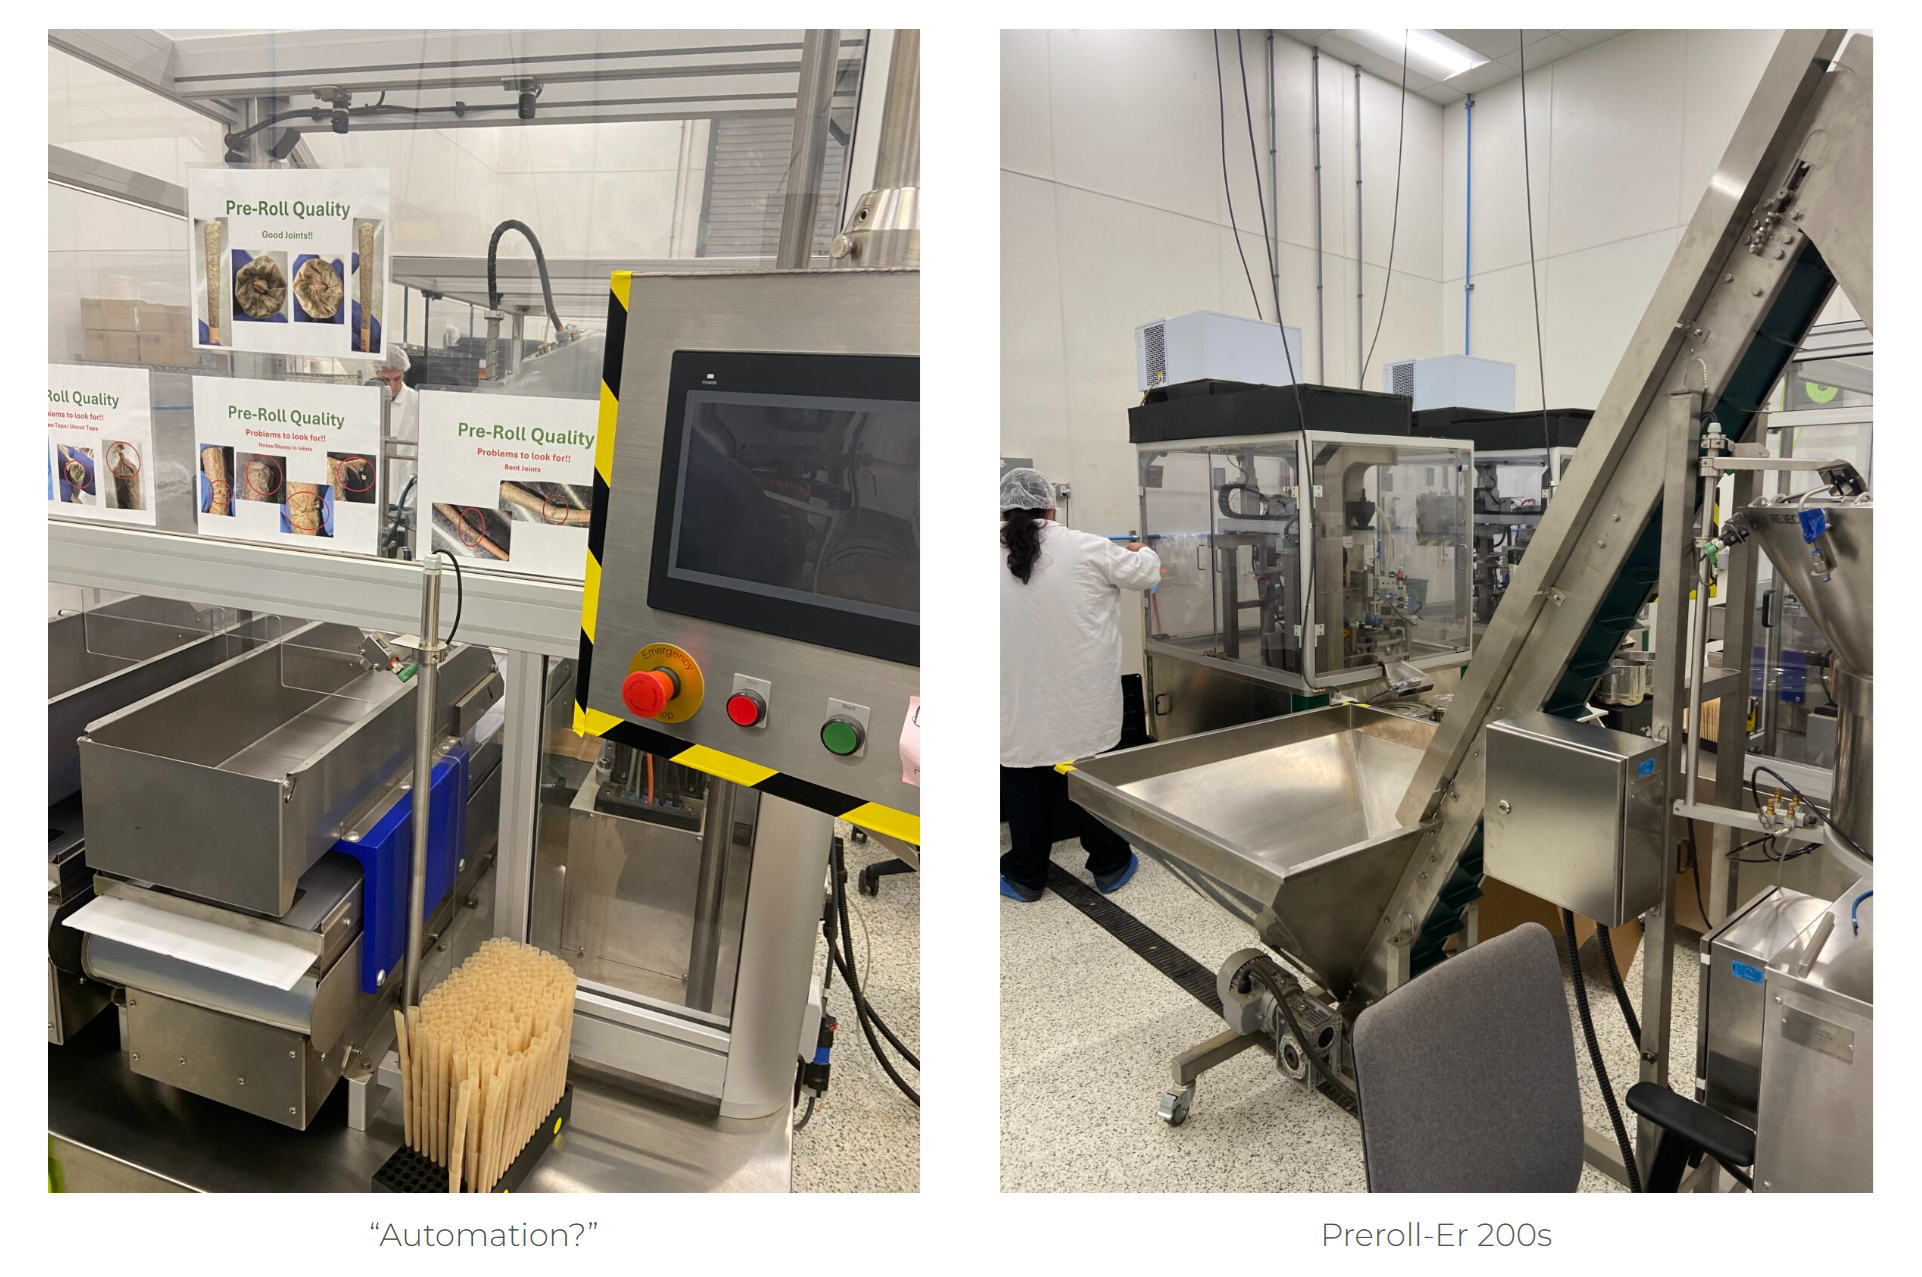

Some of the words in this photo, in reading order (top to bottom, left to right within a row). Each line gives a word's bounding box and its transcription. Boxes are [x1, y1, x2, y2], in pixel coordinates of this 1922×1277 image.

[226, 200, 289, 216] Pre-Roll
[292, 201, 350, 220] Quality
[261, 230, 284, 239] Good
[285, 231, 313, 240] Joints!!
[72, 391, 119, 409] Quality
[90, 413, 104, 421] for!!
[228, 405, 287, 423] Pre-Roll
[290, 410, 345, 429] Quality
[245, 428, 281, 439] Problems
[292, 433, 309, 441] look
[310, 433, 326, 442] for!!
[458, 422, 526, 441] Pre-Roll
[531, 428, 595, 450] Quality
[477, 448, 518, 459] Problems
[520, 452, 530, 460] to
[531, 452, 551, 462] look
[552, 454, 571, 463] for!!
[521, 465, 541, 473] Joints
[1769, 514, 1800, 524] REJEC
[641, 647, 694, 671] Emergency
[842, 703, 856, 711] Start
